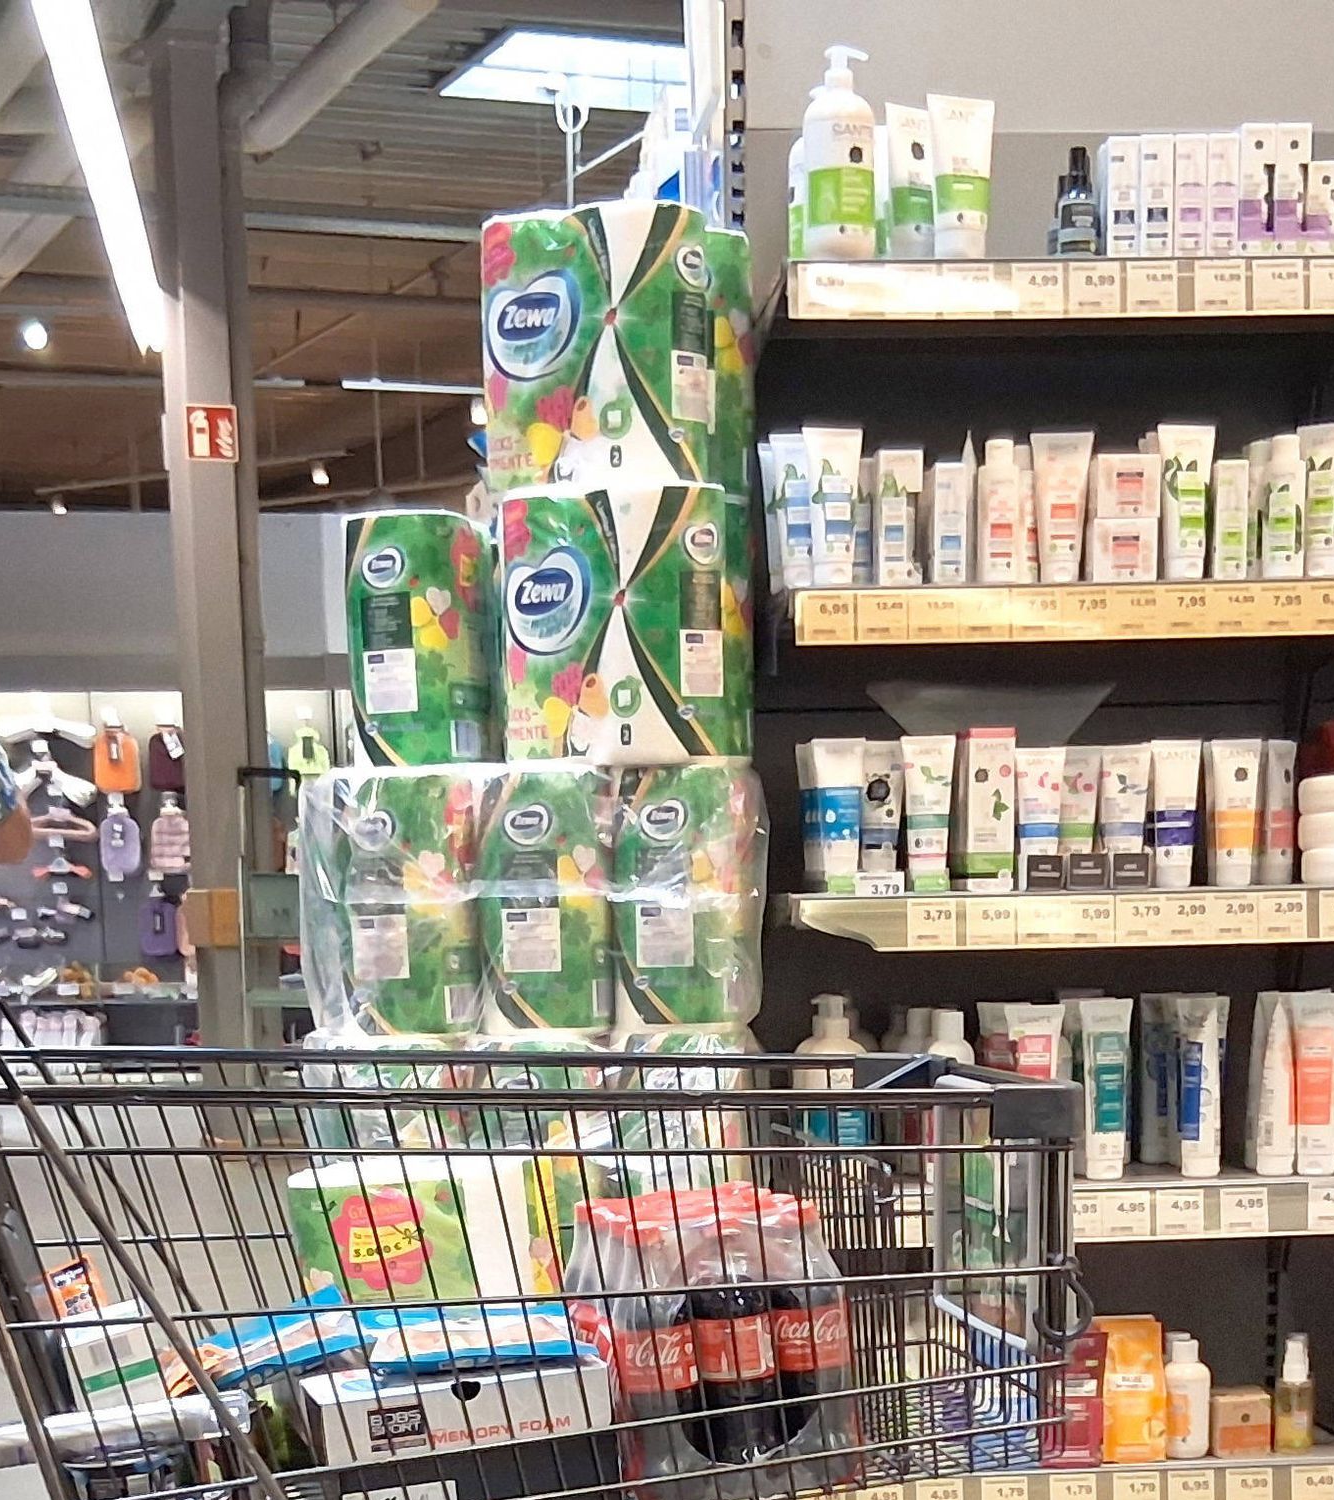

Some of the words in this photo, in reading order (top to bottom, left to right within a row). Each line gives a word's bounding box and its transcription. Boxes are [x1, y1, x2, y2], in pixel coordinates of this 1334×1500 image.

[503, 292, 557, 330] Zewa
[520, 579, 567, 606] Zewa
[1077, 598, 1108, 612] 7,95
[1176, 595, 1207, 609] 7,95
[871, 883, 900, 896] 3,79
[923, 909, 952, 923] 3,79
[1132, 905, 1161, 918] 3,79
[354, 1245, 391, 1258] 5.00
[431, 1426, 514, 1444] MEMORY
[519, 1416, 571, 1434] FOAM
